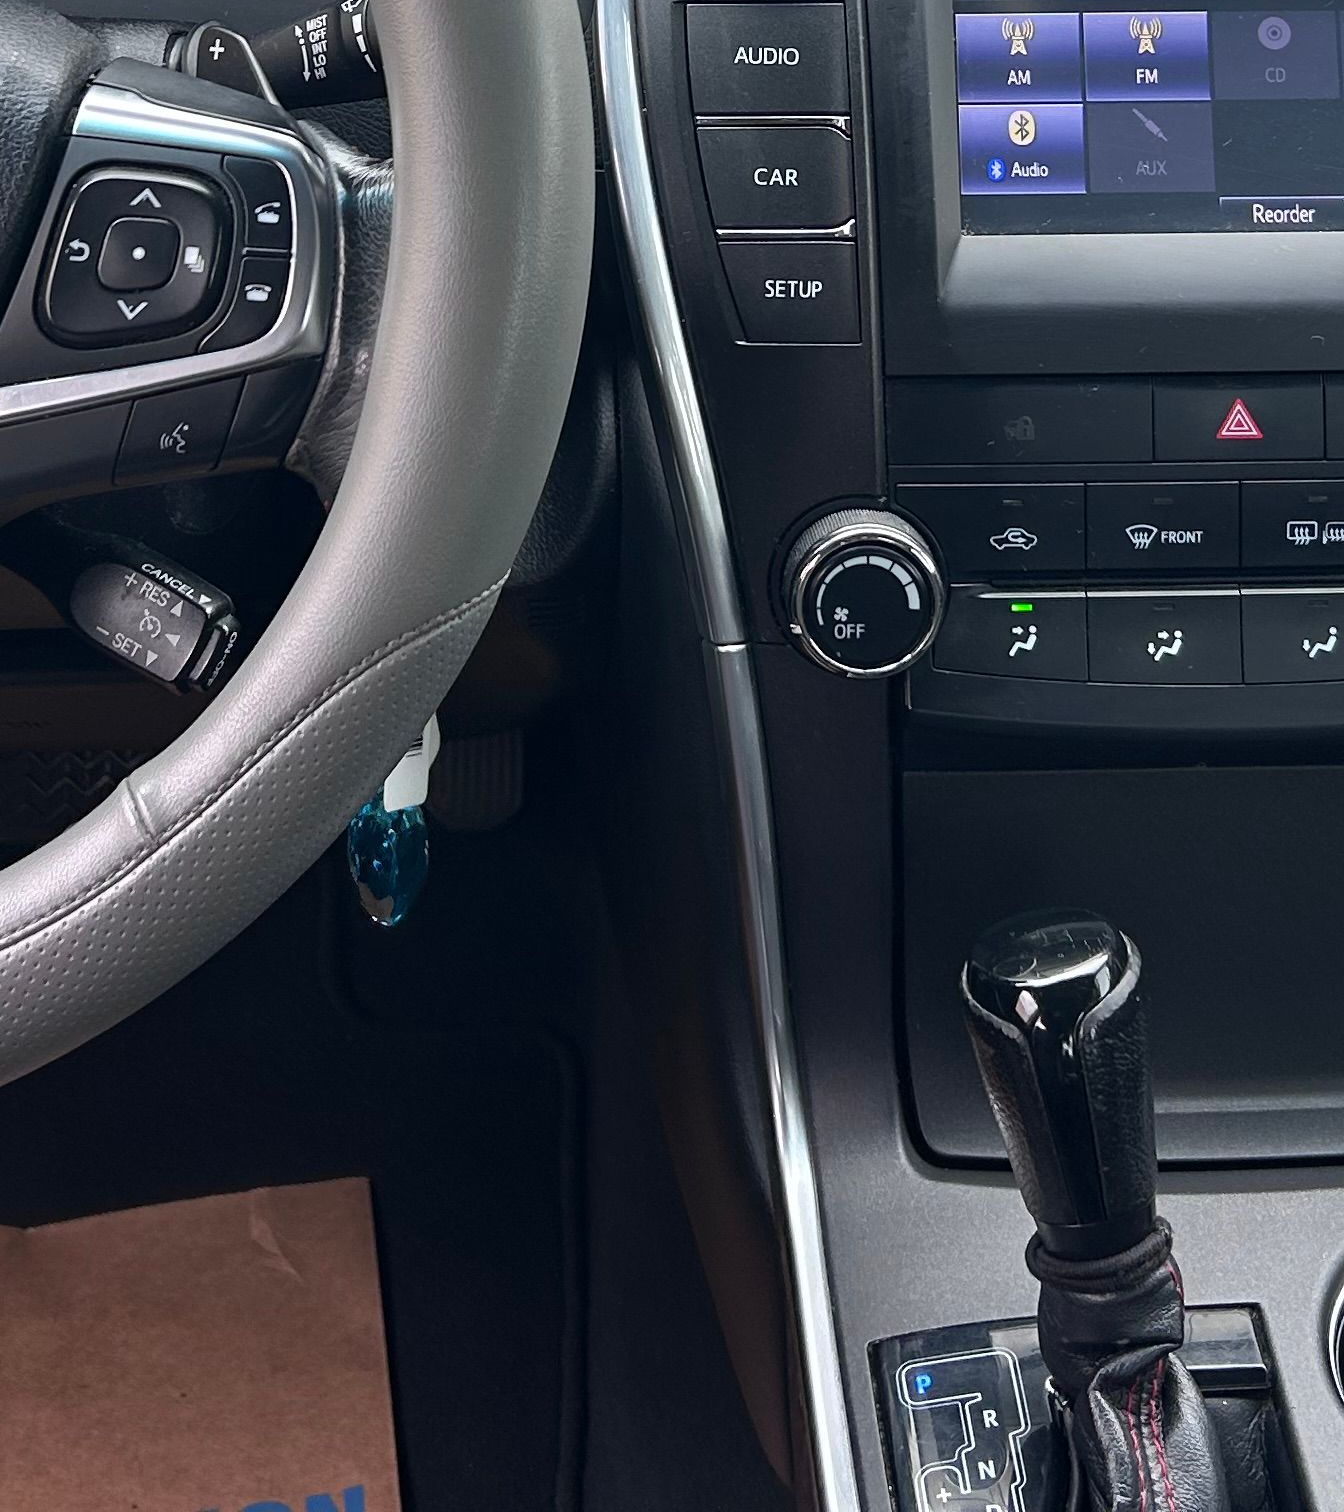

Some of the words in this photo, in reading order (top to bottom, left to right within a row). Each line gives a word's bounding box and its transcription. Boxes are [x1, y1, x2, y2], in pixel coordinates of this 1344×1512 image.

[306, 13, 328, 32] MIST
[309, 27, 327, 43] OFF
[311, 40, 327, 55] INT
[734, 46, 800, 67] AUDIO
[313, 54, 327, 68] LO
[314, 67, 327, 80] HI
[1007, 69, 1032, 86] AM
[1135, 68, 1159, 85] FM
[1264, 66, 1287, 84] CD
[753, 168, 799, 187] CAR
[1010, 161, 1050, 178] Audio
[1136, 160, 1168, 177] AUX
[1252, 203, 1316, 224] Reorder
[764, 279, 824, 299] SETUP
[1160, 531, 1204, 544] FRONT
[141, 563, 195, 600] CANCEL
[139, 580, 171, 607] RES
[834, 623, 866, 640] OFF
[111, 632, 143, 657] SET
[914, 1374, 932, 1394] P
[982, 1409, 1000, 1429] R
[977, 1459, 997, 1480] N
